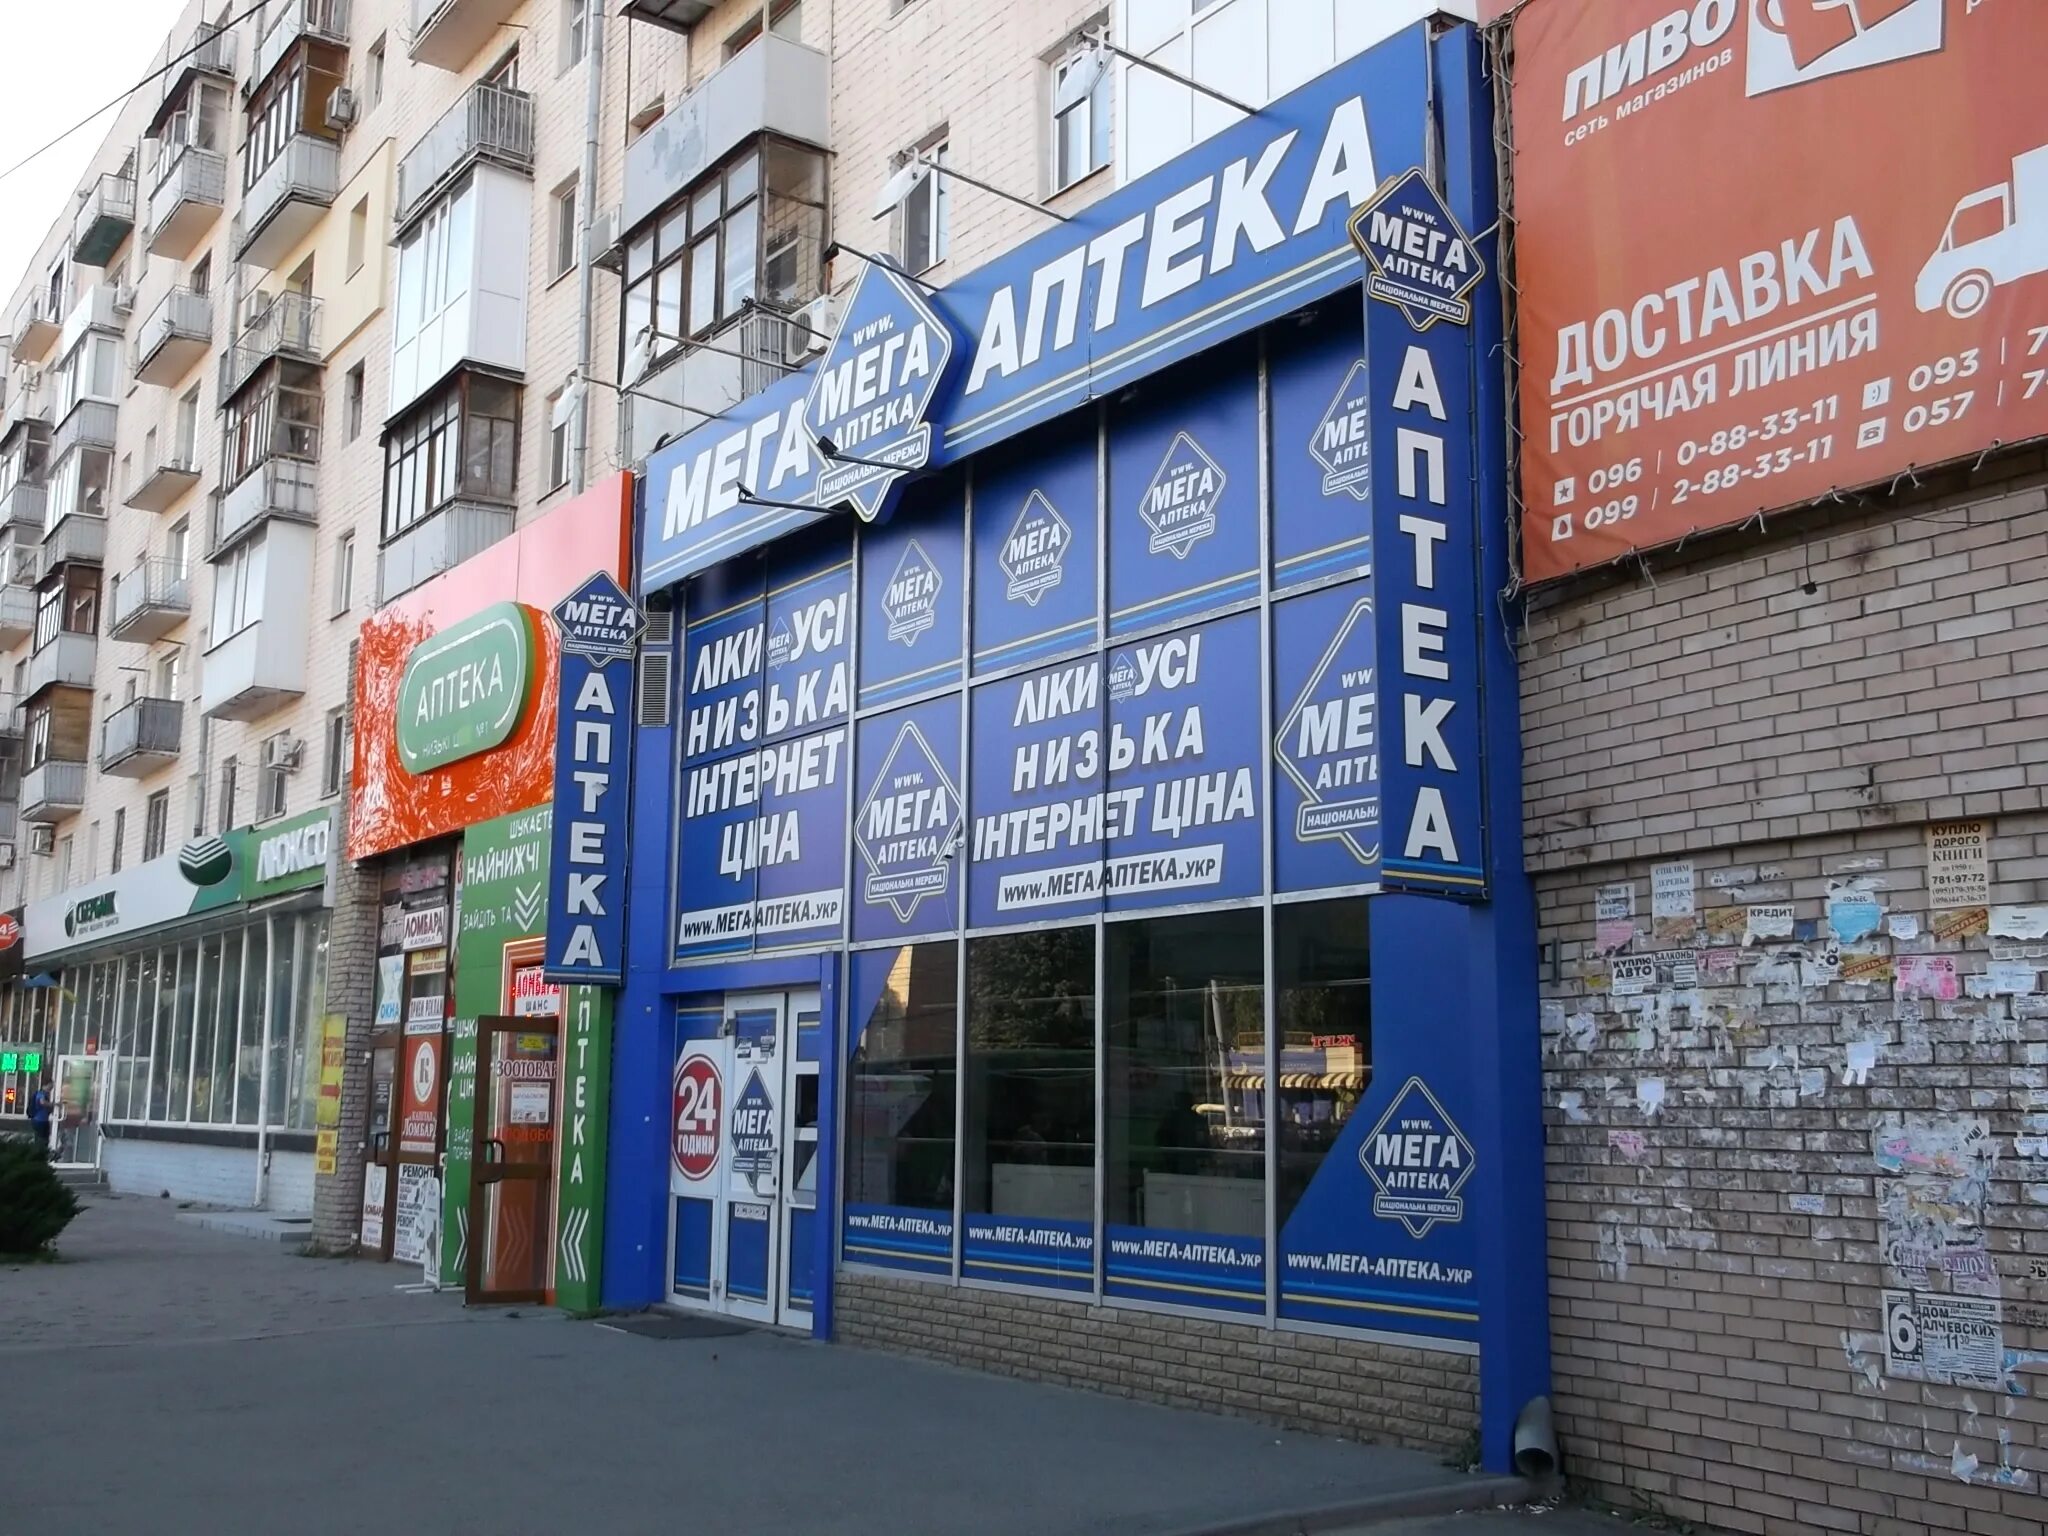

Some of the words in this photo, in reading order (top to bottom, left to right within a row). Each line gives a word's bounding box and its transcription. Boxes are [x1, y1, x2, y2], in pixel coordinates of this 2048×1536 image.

[1562, 0, 1737, 122] ПИВО
[1564, 115, 1609, 147] сеть
[1615, 48, 1733, 121] магазинов
[1402, 204, 1438, 226] www.
[965, 95, 1377, 396] АПТЕКА
[1369, 210, 1467, 274] МЕГА
[1382, 253, 1456, 292] АПТЕКА
[1375, 281, 1428, 306] НАЦІОНАЛЬНА
[1429, 299, 1462, 316] МЕРЕЖА
[1550, 215, 1874, 396] ДОСТАВКА
[853, 314, 894, 348] www.
[818, 321, 929, 427] МЕГА
[1550, 358, 1717, 454] ГОРЯЧАЯ
[1728, 307, 1878, 397] ЛИНИЯ
[1908, 347, 1980, 393] 093
[831, 393, 915, 451] АПТЕКА
[1323, 408, 1367, 452] МЕ
[1677, 395, 1839, 466] 0-88-33-11
[1903, 390, 1975, 433] 057
[662, 397, 811, 542] МЕГА
[1587, 457, 1642, 494] 096
[1671, 434, 1833, 505] 2-88-33-11
[1150, 467, 1214, 514] МЕГА
[1159, 499, 1207, 528] АПТЕКА
[1583, 495, 1638, 530] 099
[1008, 522, 1061, 564] МЕГА
[1015, 552, 1055, 577] АПТЕКА
[889, 570, 934, 607] МЕГА
[1392, 345, 1458, 863] АПТЕКА
[564, 600, 636, 629] МЕГА
[894, 597, 928, 619] АПТЕКА
[573, 625, 628, 641] АПТЕКА
[691, 622, 765, 695] ЛІКИ
[789, 592, 848, 663] УСІ
[415, 652, 504, 728] АПТЕКА
[1013, 661, 1099, 728] ЛІКИ
[1135, 633, 1201, 697] УСІ
[687, 661, 849, 758] НИЗЬКА
[1297, 692, 1375, 759] МЕ
[1012, 706, 1204, 793] НИЗЬКА
[686, 729, 845, 819] ІНТЕРНЕТ
[894, 772, 924, 789] www.
[562, 672, 615, 967] АПТЕКА
[867, 786, 948, 841] МЕГА
[973, 786, 1144, 863] ІНТЕРНЕТ
[1152, 767, 1255, 839] ЦІНА
[1931, 823, 1982, 836] КУПЛЮ
[719, 809, 800, 882] ЦІНА
[876, 835, 938, 865] АПТЕКА
[1932, 848, 1983, 862] КНИГИ
[1933, 835, 1980, 849] ДОРОГО
[466, 840, 540, 887] НАЙНИЖЧІ
[1931, 873, 1985, 885] 781-97-72
[463, 908, 497, 932] ЗАЙДІТЬ
[501, 905, 512, 923] ТА
[1749, 908, 1793, 919] КРЕДИТ
[1612, 957, 1652, 969] КУПЛЮ
[1615, 965, 1653, 980] АВТО
[1654, 950, 1695, 961] БАЛКОНЫ
[1842, 955, 1889, 978] ЖИЛЬЕ
[525, 1000, 549, 1012] ШАНС
[677, 1075, 717, 1132] 24
[733, 1109, 774, 1136] МЕГА
[1401, 1120, 1433, 1130] www.
[677, 1134, 715, 1156] ГОДИНИ
[1374, 1133, 1460, 1169] МЕГА
[402, 1164, 434, 1178] РЕМОНТ
[1385, 1171, 1450, 1190] АПТЕКА
[1890, 1304, 1918, 1353] 6
[1922, 1306, 1949, 1318] ДОМ
[1923, 1319, 1996, 1337] АЛЧЕВСКИХ
